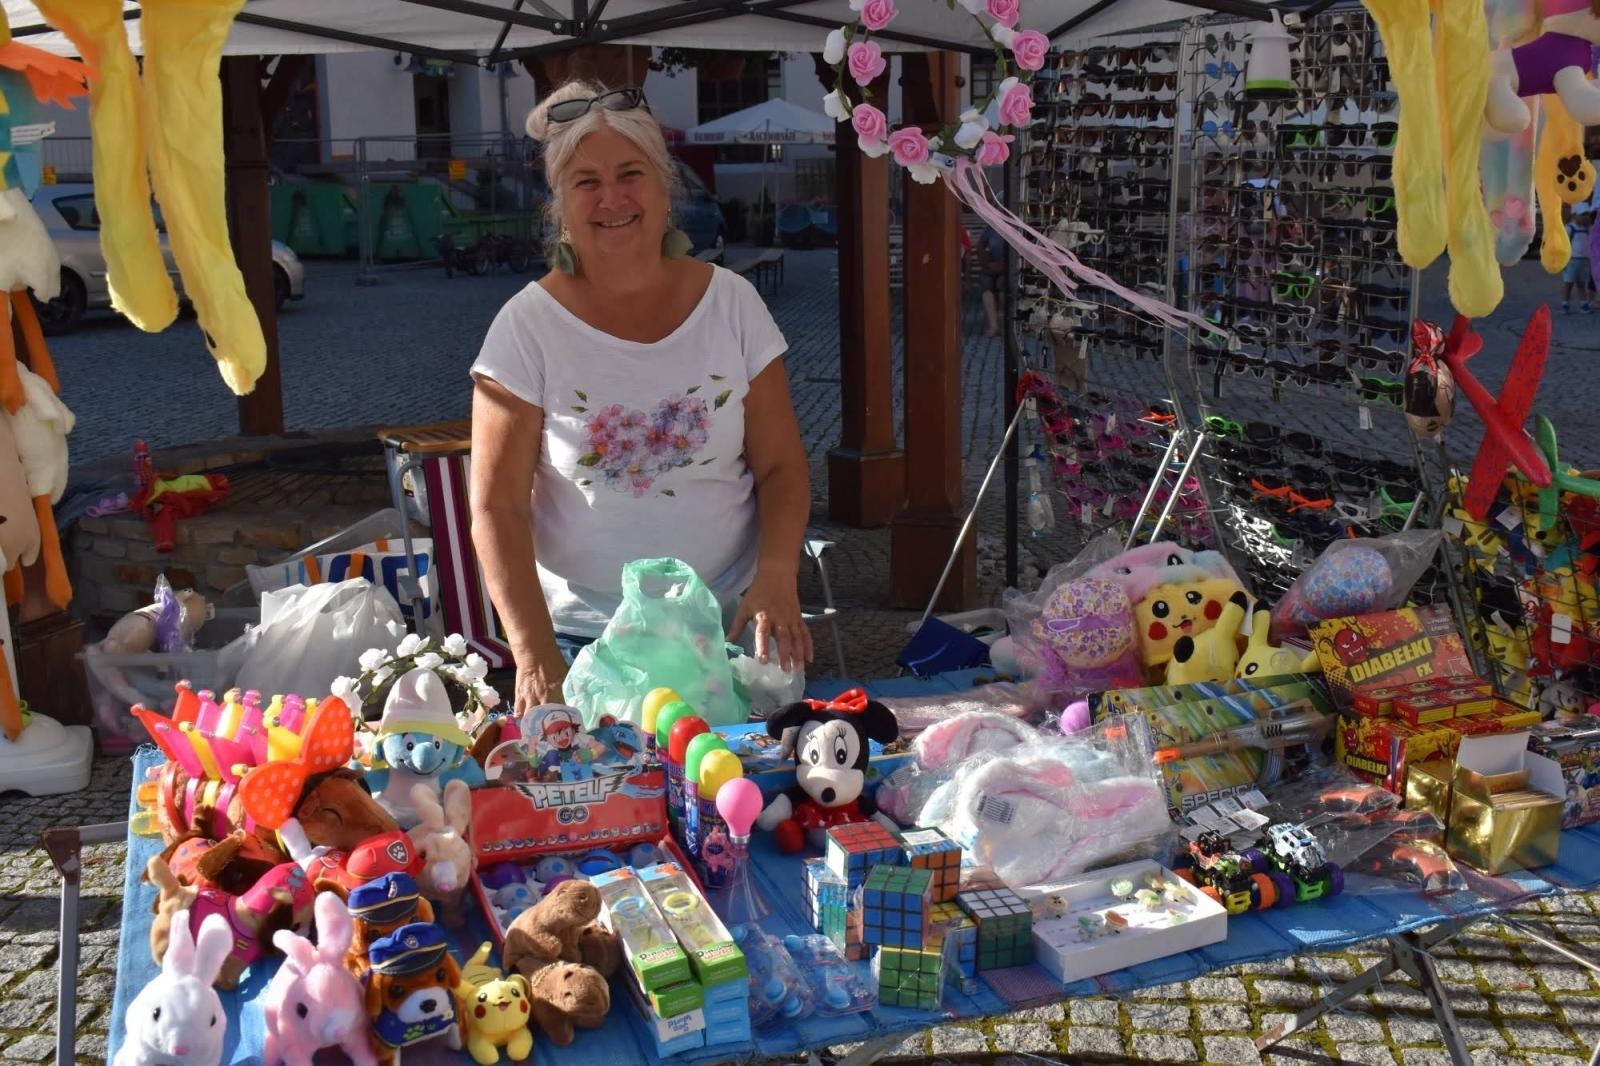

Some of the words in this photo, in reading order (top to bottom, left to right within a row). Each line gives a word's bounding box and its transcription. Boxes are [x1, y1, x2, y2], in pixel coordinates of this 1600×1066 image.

[1349, 637, 1433, 683] DIABEŁKI
[1416, 663, 1434, 678] FX
[558, 805, 588, 823] GO
